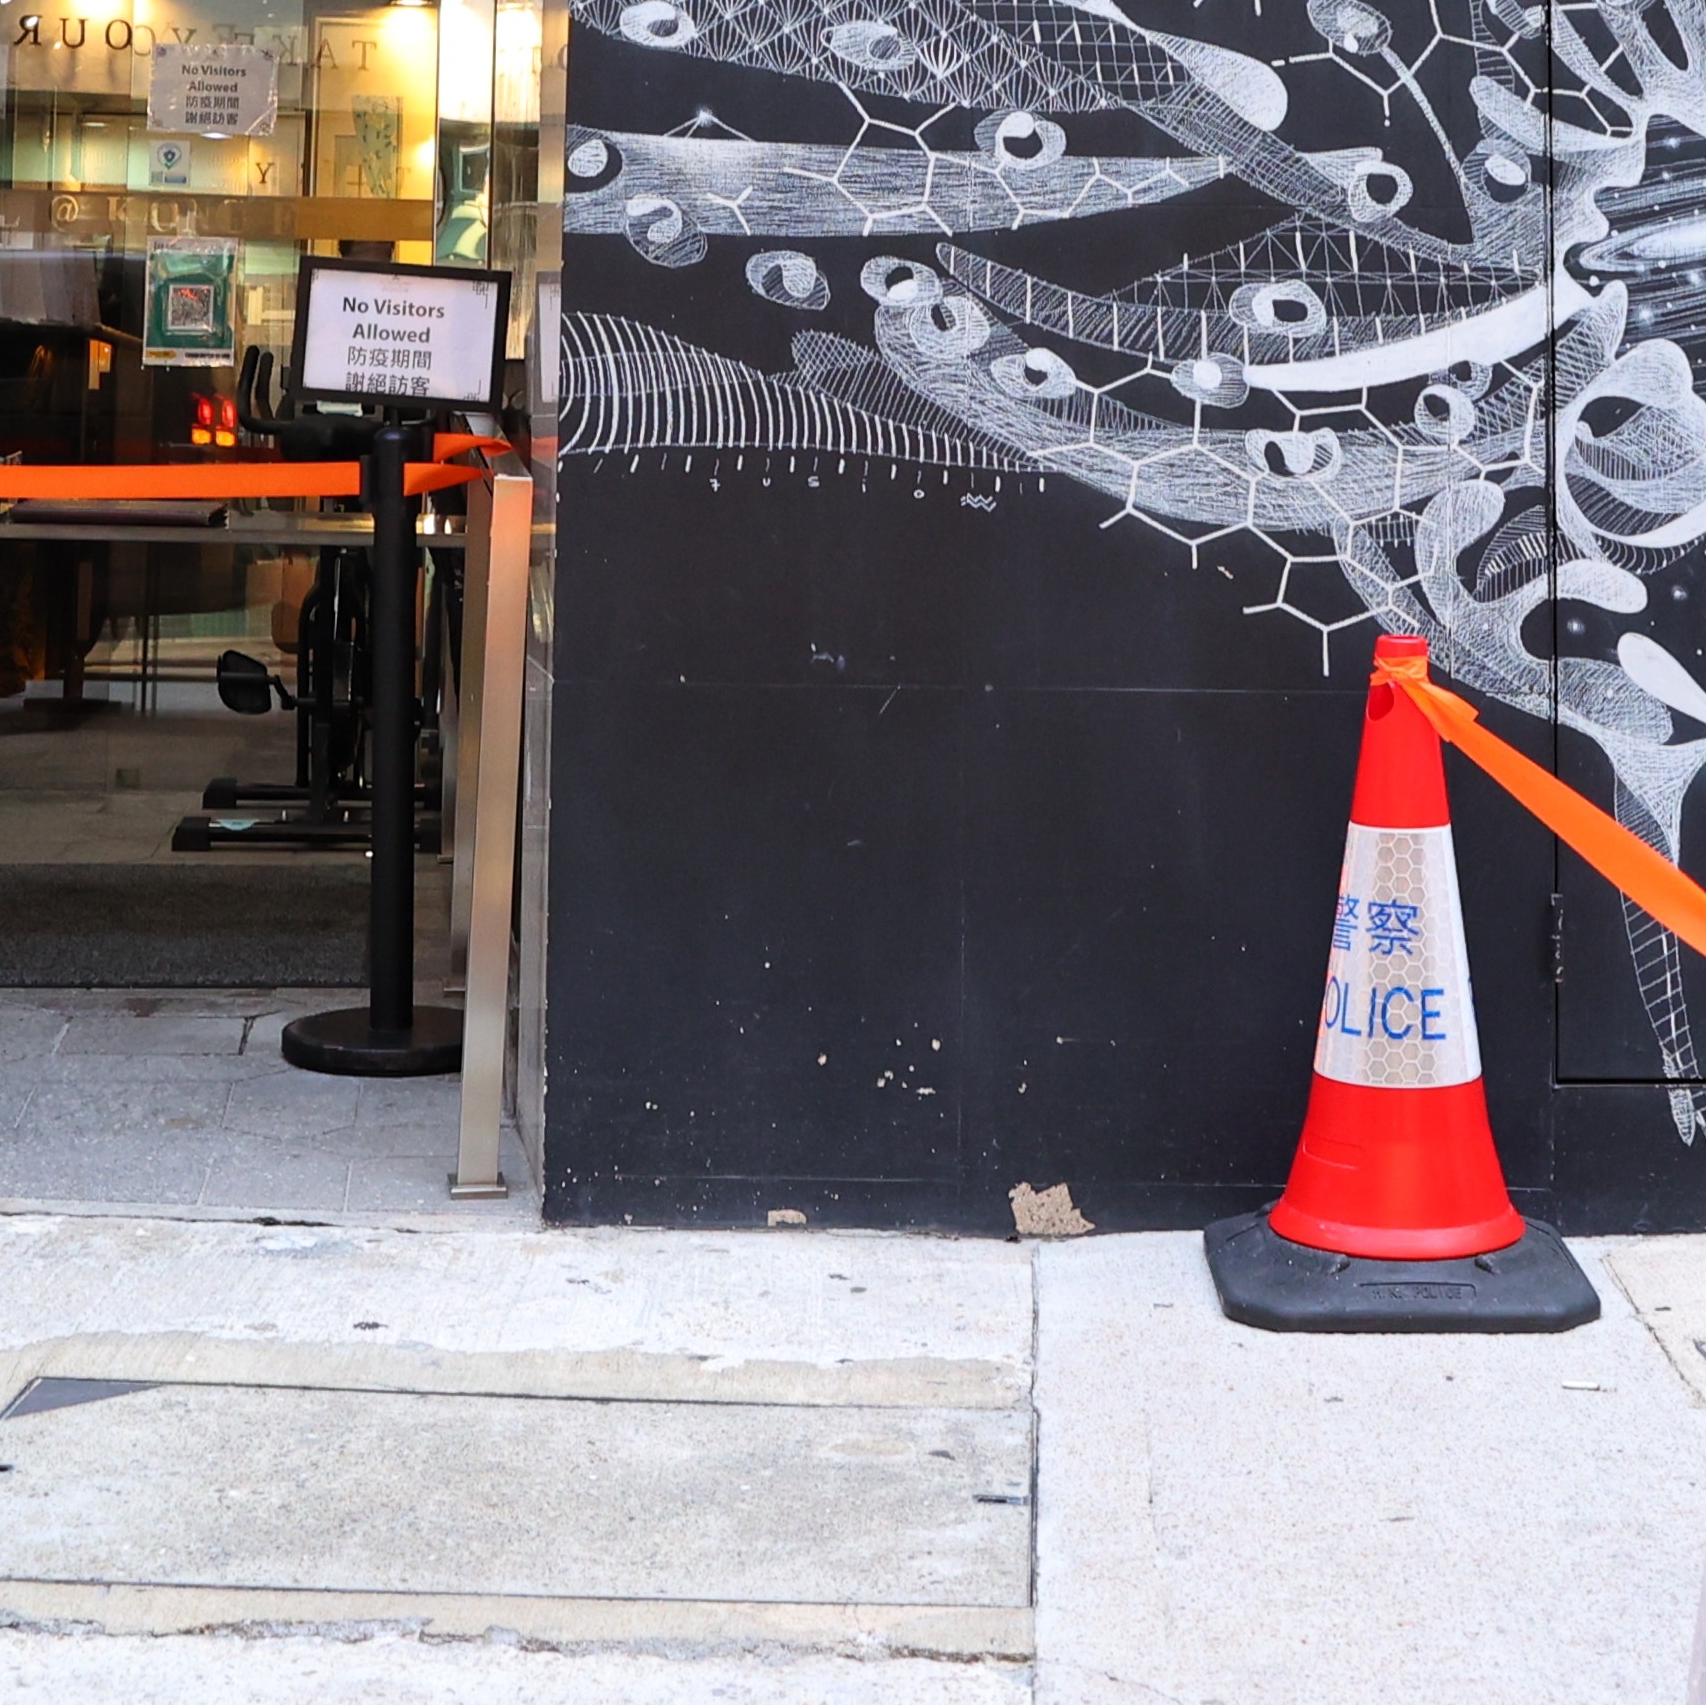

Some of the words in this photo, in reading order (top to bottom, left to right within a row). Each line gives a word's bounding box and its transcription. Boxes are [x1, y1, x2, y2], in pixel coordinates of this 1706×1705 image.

[181, 65, 199, 75] No
[201, 65, 246, 77] Visitors
[188, 80, 238, 93] Allowed
[185, 95, 239, 110] 防疫期間
[342, 296, 369, 314] No
[374, 299, 445, 318] Visitors
[352, 323, 431, 344] Allowed
[347, 346, 432, 371] 防疫期間
[345, 371, 430, 396] 謝絕訪客
[1333, 894, 1420, 956] 警察
[1325, 975, 1447, 1041] OLICE
